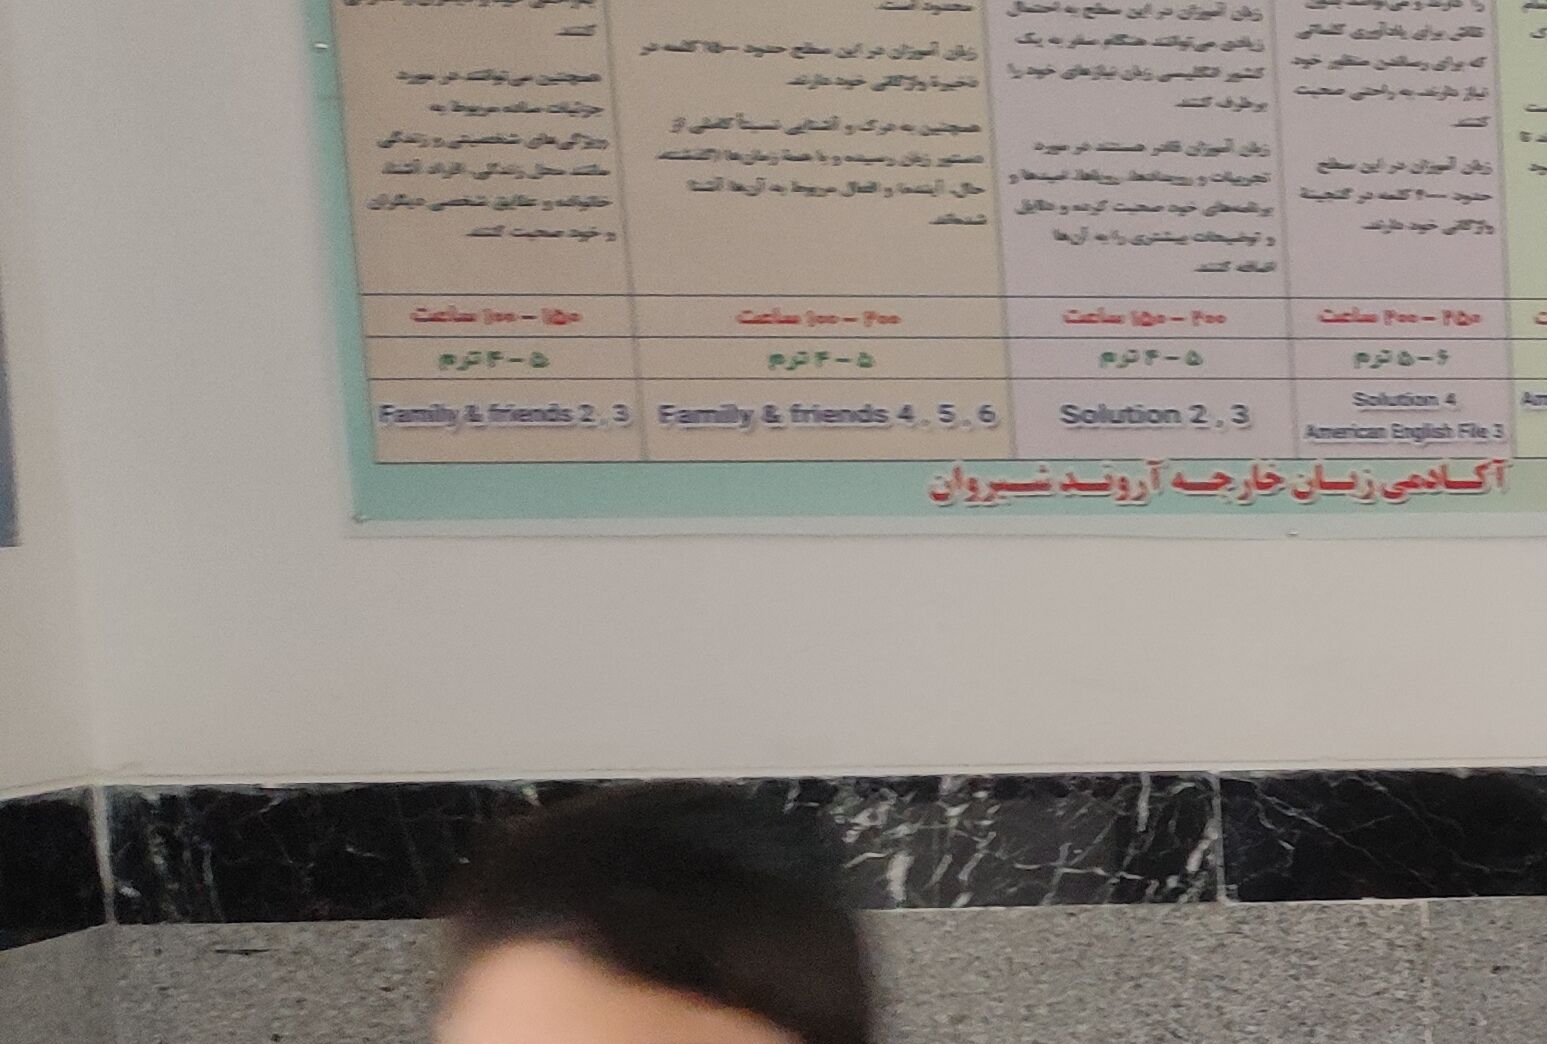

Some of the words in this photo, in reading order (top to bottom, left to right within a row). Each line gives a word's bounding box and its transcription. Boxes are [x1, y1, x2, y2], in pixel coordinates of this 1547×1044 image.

[1352, 392, 1439, 406] Solution
[379, 404, 458, 430] Family
[490, 404, 574, 422] friends
[658, 404, 754, 430] Family
[790, 404, 889, 423] friends
[1060, 403, 1182, 424] Solution
[1305, 424, 1387, 439] American
[1391, 423, 1453, 442] English
[1458, 423, 1489, 438] File
[929, 463, 1052, 503] شیروان
[1059, 460, 1165, 503] آروند
[1171, 463, 1283, 502] خارجه
[1291, 462, 1374, 502] زبان
